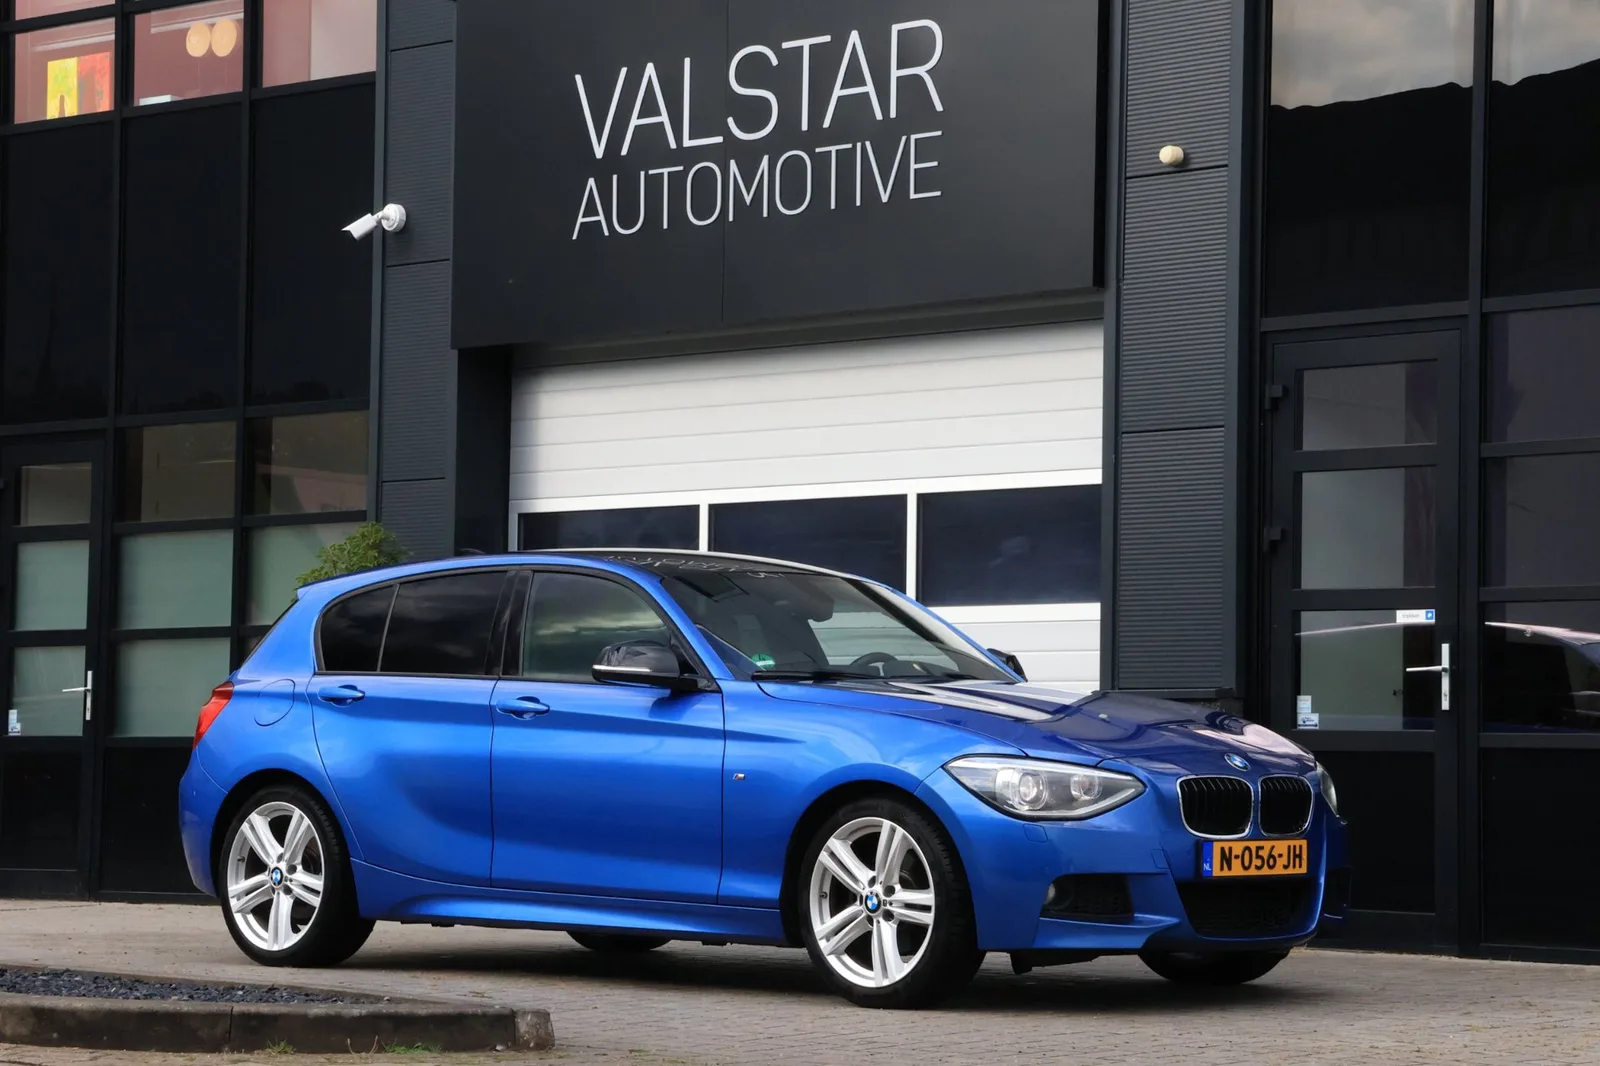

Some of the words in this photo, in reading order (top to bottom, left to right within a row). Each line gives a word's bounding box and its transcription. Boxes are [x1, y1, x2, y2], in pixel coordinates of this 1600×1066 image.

[574, 18, 944, 159] VALSTAR
[571, 130, 943, 240] AUTOMOTIVE
[1203, 862, 1212, 871] NL
[1219, 844, 1303, 872] N-056-JH
